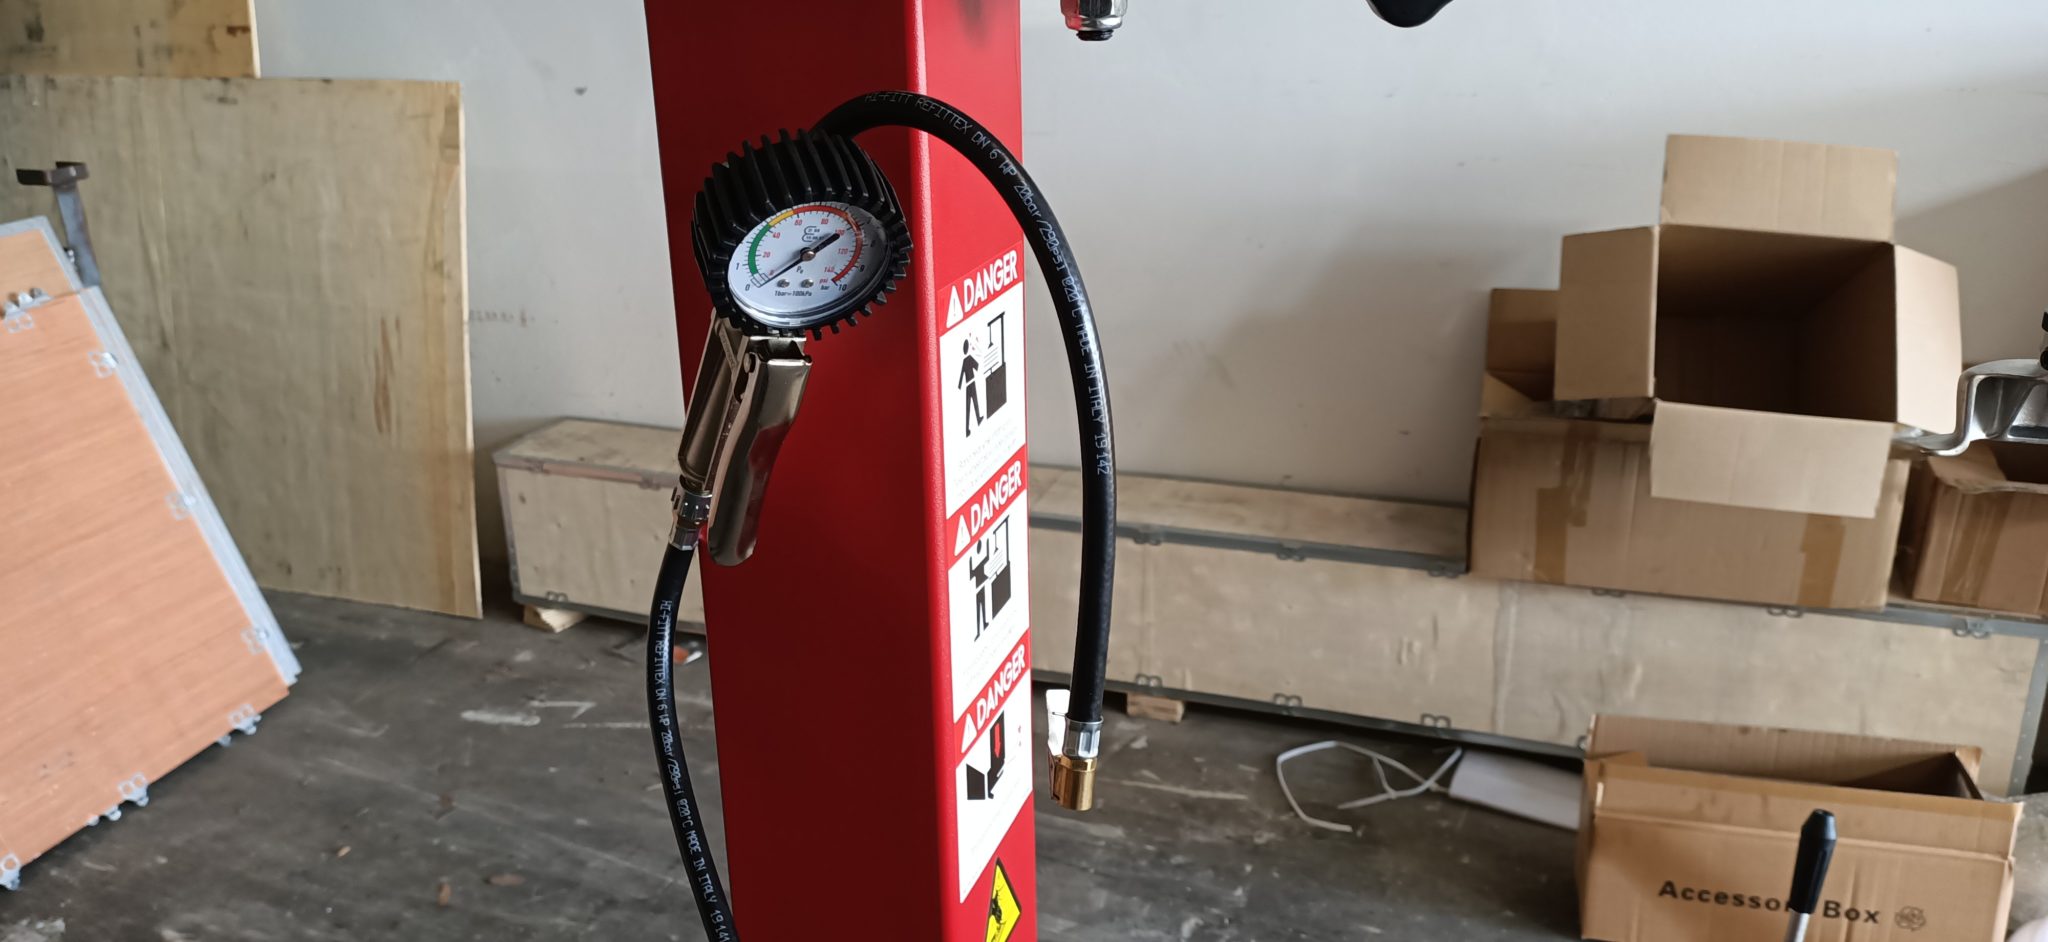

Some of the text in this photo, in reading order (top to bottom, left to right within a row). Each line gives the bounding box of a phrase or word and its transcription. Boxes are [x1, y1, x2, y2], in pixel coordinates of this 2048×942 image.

[915, 97, 974, 135] REFITTEX
[971, 131, 992, 149] DN
[989, 149, 1003, 160] 6
[999, 159, 1018, 177] WP
[838, 283, 848, 291] 10
[963, 249, 1018, 313] DANGER
[1075, 322, 1092, 357] MADE
[1084, 363, 1099, 380] IN
[1088, 386, 1105, 424] ITALY
[970, 460, 1022, 537] DANGER
[655, 688, 668, 701] DN
[976, 643, 1026, 731] DANGER
[657, 703, 668, 711] 6
[685, 830, 702, 855] MADE
[693, 857, 707, 872] IN
[698, 873, 718, 903] ITALY
[1658, 880, 1882, 924] Accessor Box
